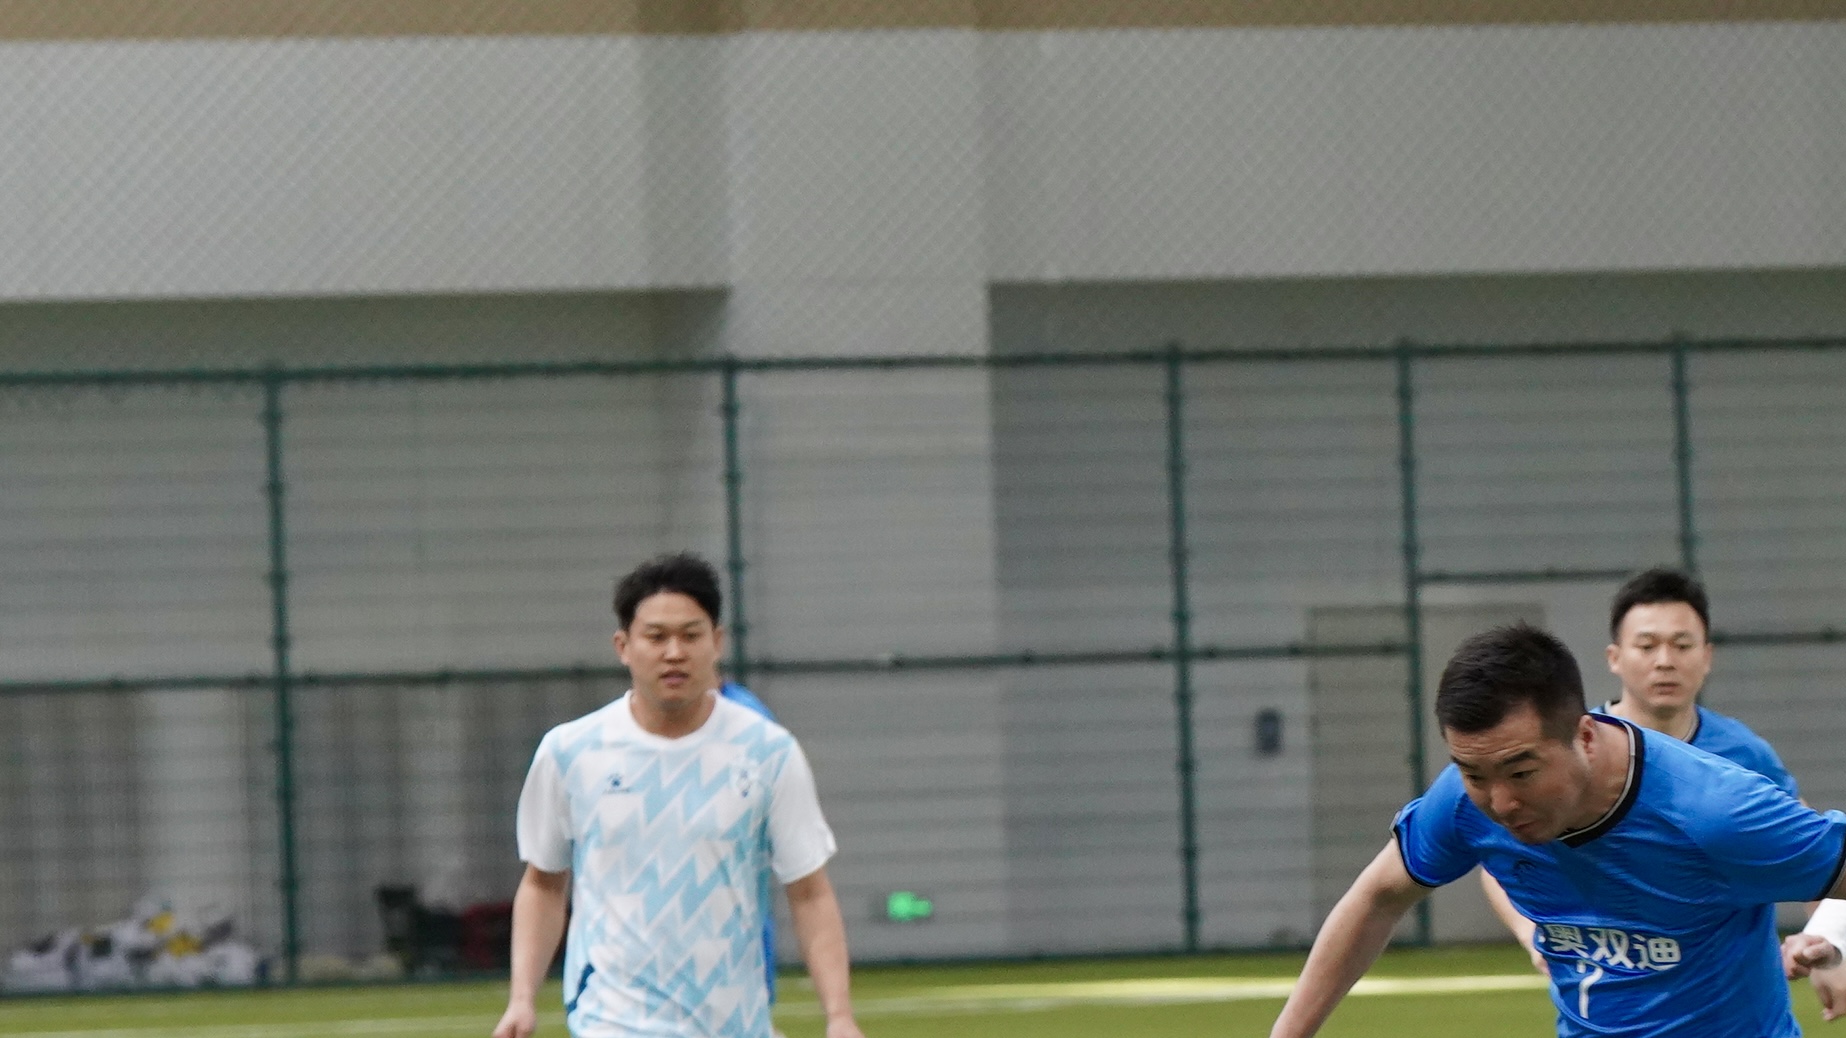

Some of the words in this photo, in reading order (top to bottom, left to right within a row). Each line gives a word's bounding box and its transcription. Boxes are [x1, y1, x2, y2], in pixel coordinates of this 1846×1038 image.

[1538, 924, 1682, 971] 奥双迪
[1576, 958, 1604, 1019] 7
